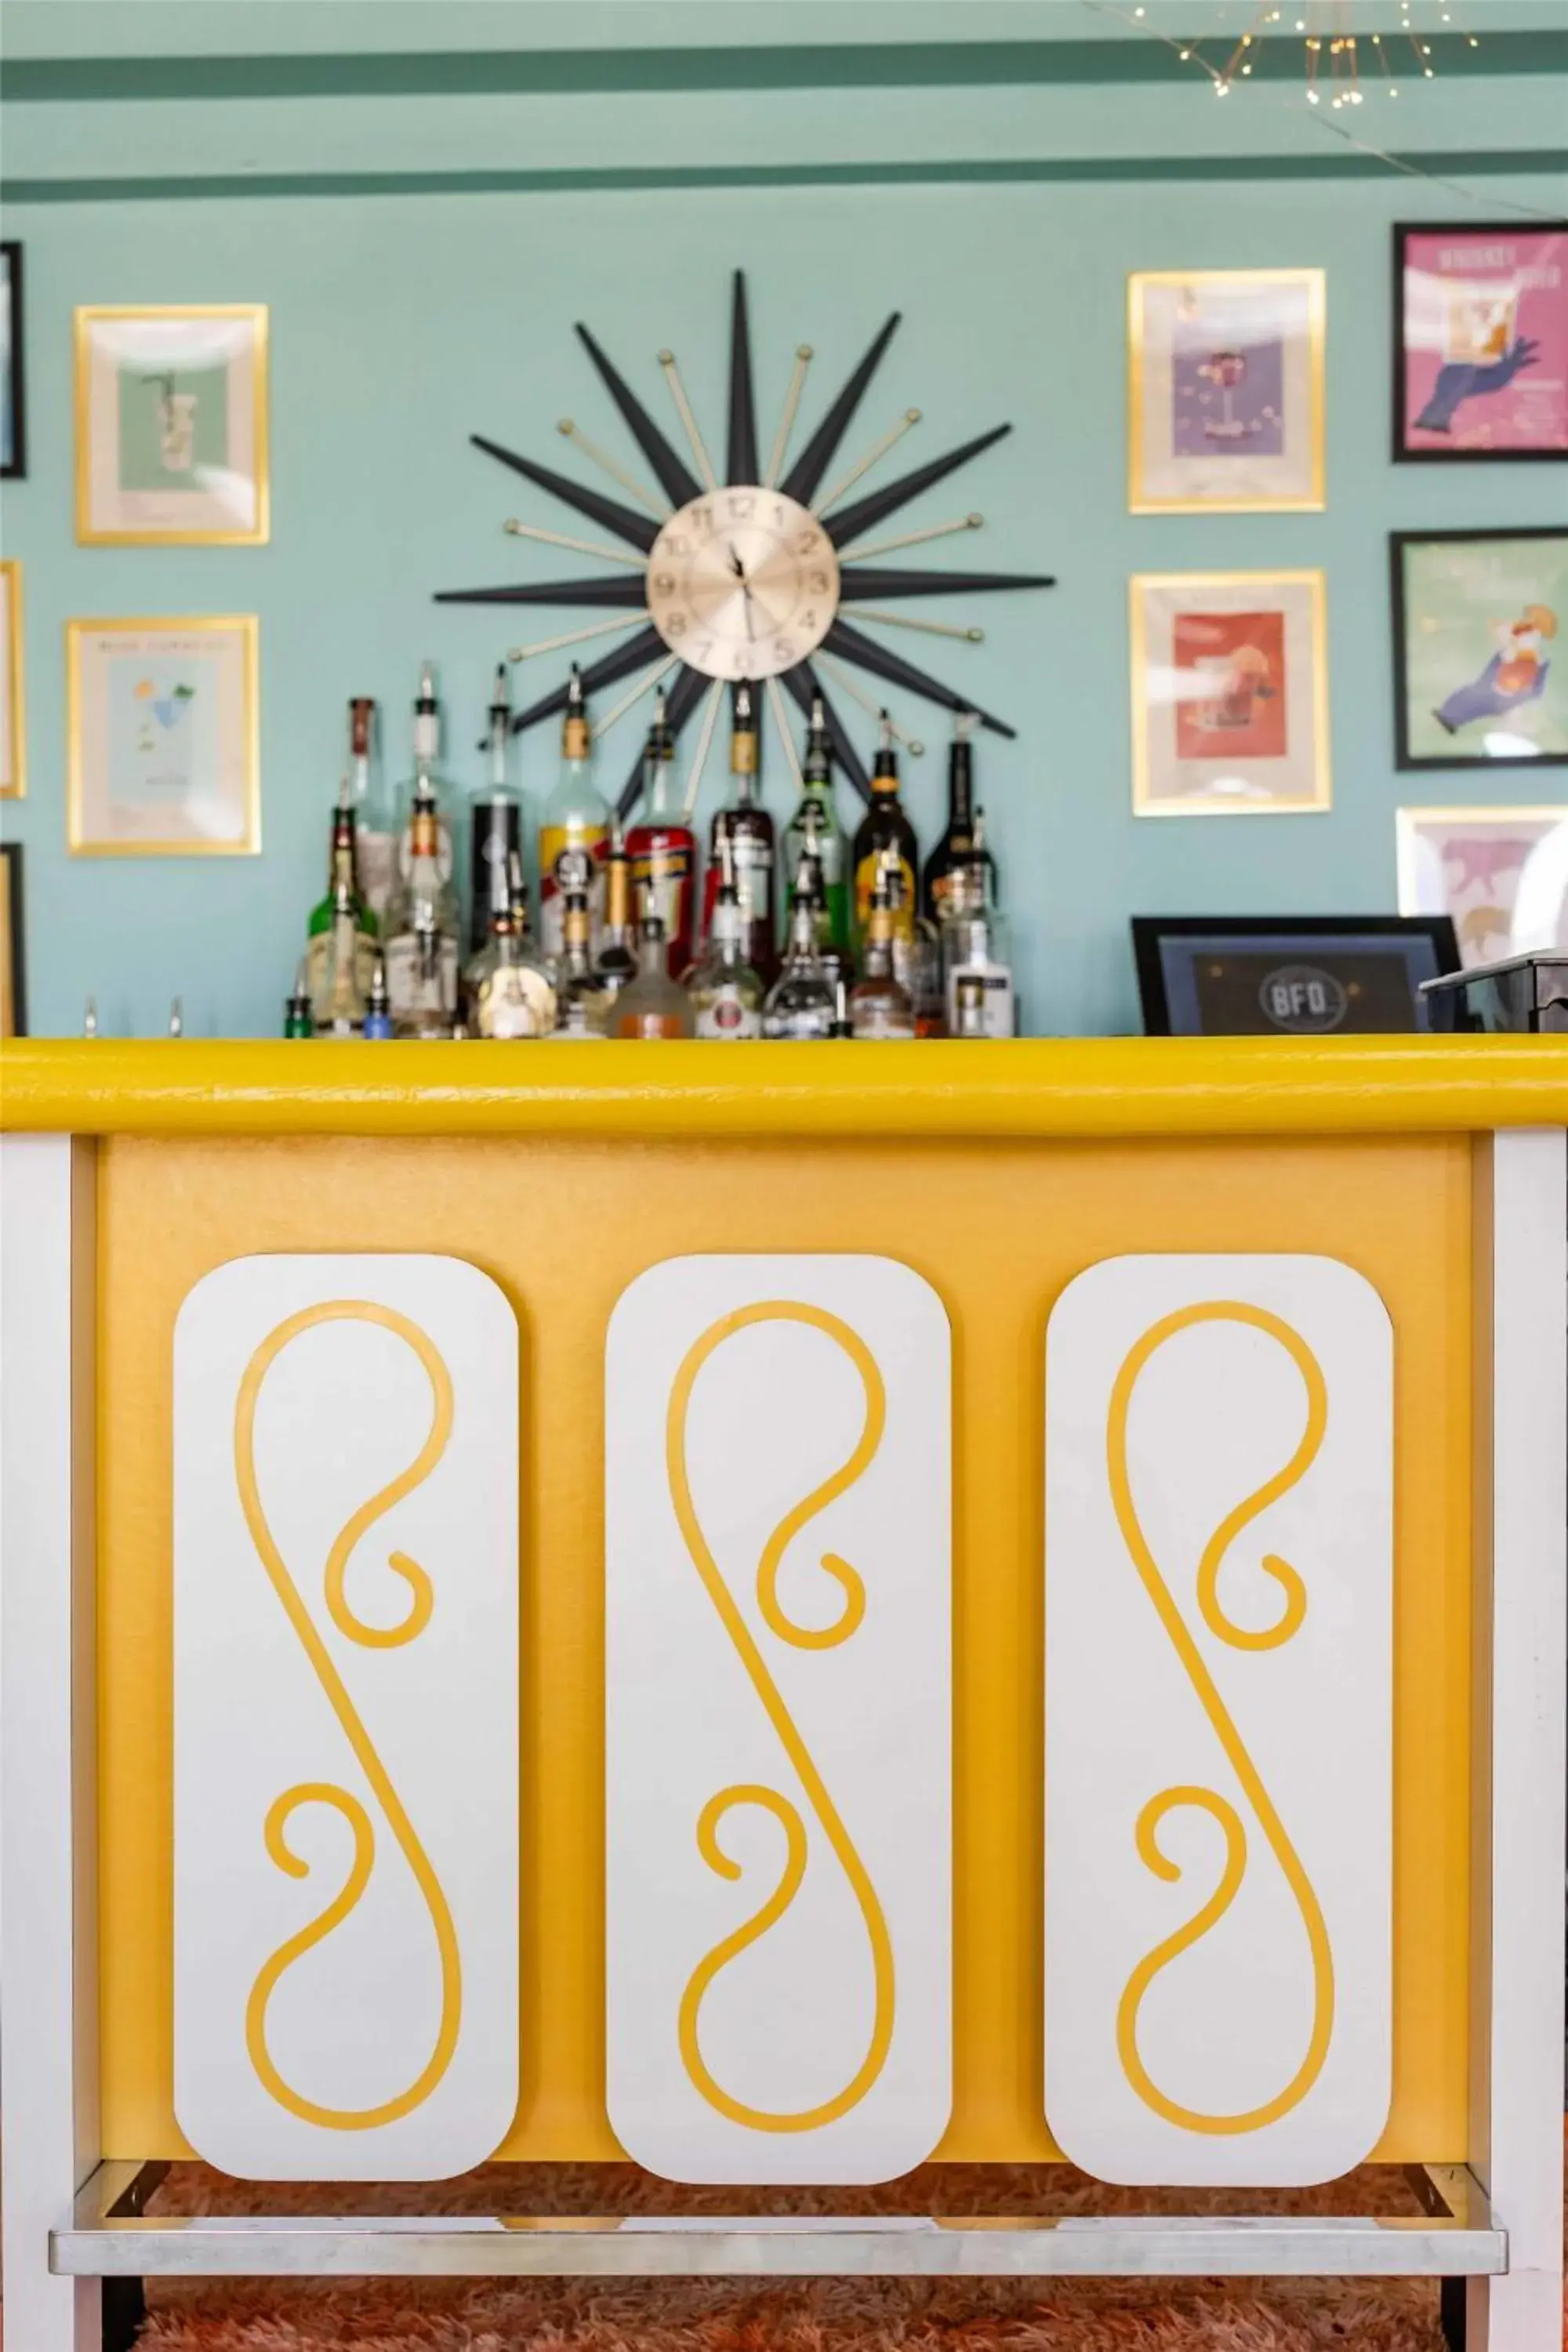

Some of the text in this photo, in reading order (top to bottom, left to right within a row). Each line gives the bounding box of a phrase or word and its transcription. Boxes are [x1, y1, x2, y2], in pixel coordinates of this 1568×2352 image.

[774, 505, 784, 527] 1
[797, 530, 819, 554] 2
[653, 572, 677, 598] 9
[808, 569, 830, 595] 3
[666, 611, 688, 637] 8
[695, 641, 713, 663] 7
[773, 637, 795, 663] 5
